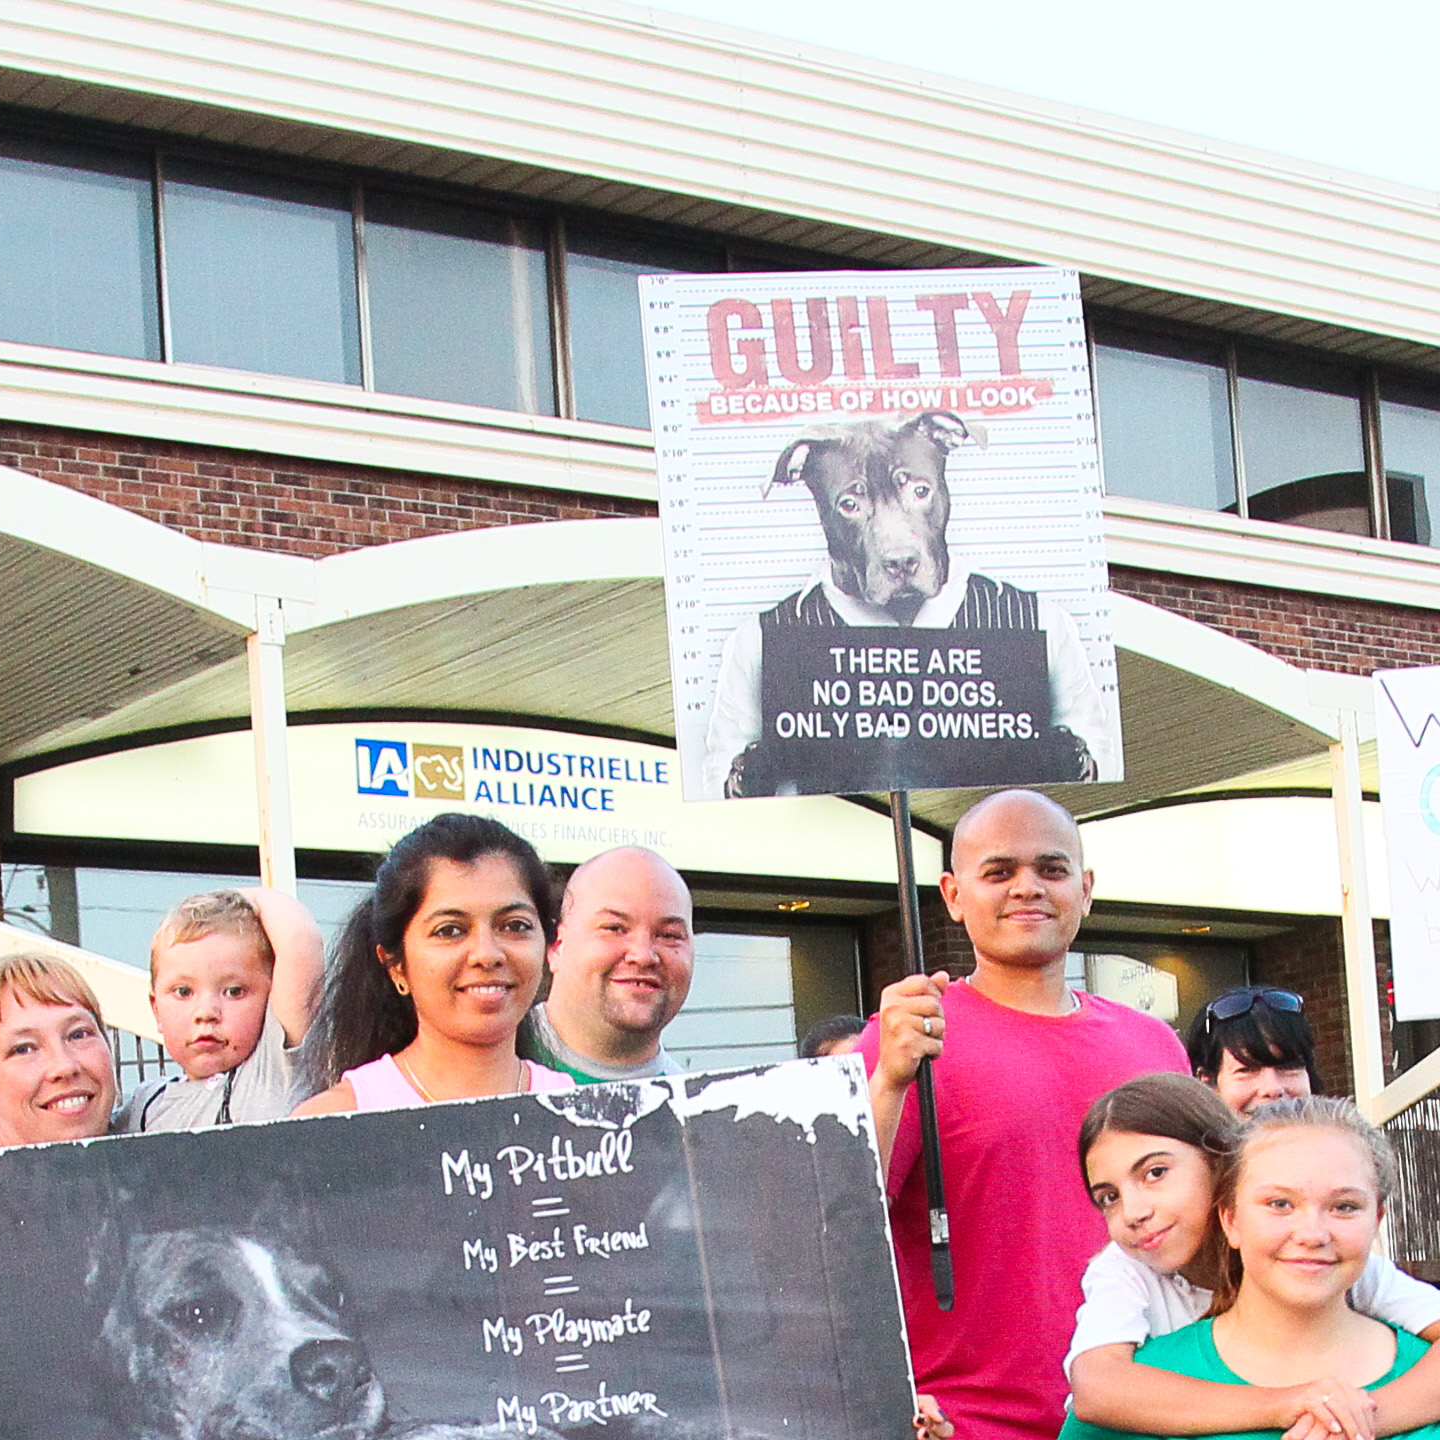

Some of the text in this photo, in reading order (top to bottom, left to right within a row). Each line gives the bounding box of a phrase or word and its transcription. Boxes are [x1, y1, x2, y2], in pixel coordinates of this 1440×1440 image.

[707, 290, 1032, 389] GUILTY
[711, 386, 1037, 416] BECAUSE OF HOW I LOOK
[830, 648, 982, 675] THERE ARE
[812, 680, 1003, 707] NO BAD DOGS.
[776, 712, 1040, 740] ONLY BAD OWNERS.
[472, 746, 671, 785] INDUSTRIELLE
[472, 779, 617, 813] ALLIANCE
[553, 823, 639, 845] FINANCIERS
[643, 831, 673, 848] INC.
[441, 1129, 634, 1199] My Pitbull
[462, 1238, 498, 1273] My
[506, 1227, 566, 1267] Best
[482, 1298, 651, 1356] My Playmate
[496, 1395, 539, 1434] My
